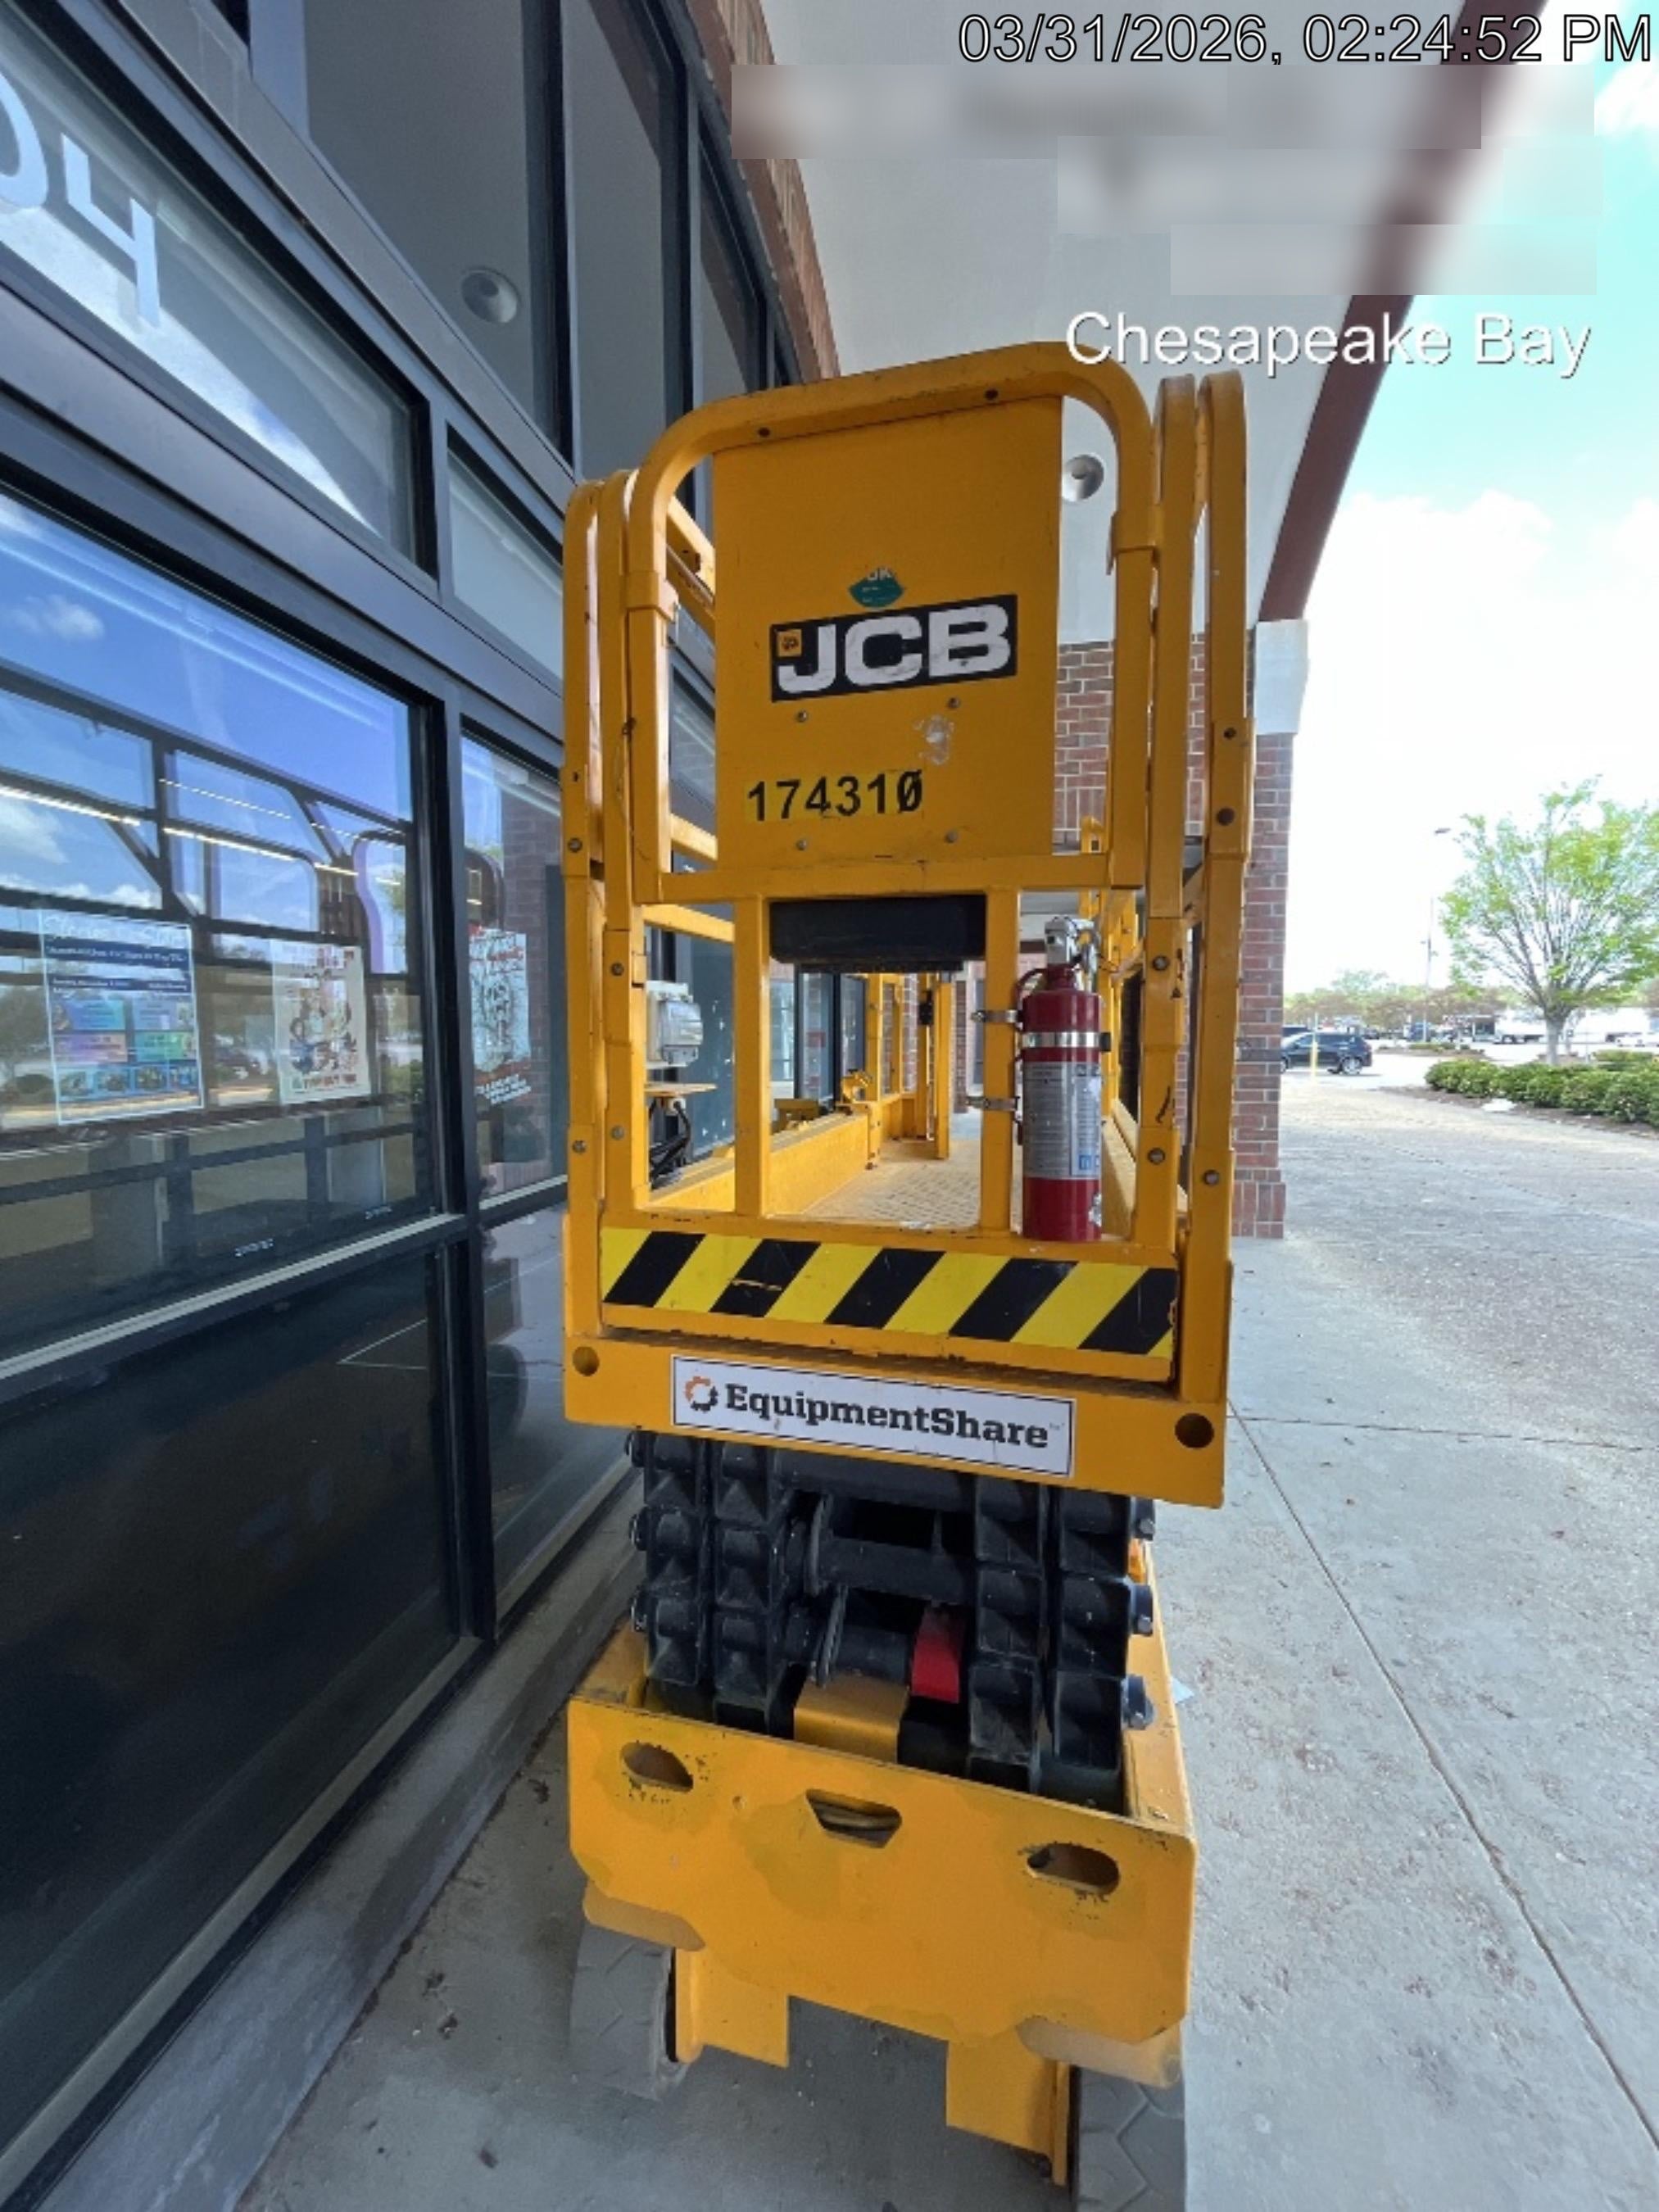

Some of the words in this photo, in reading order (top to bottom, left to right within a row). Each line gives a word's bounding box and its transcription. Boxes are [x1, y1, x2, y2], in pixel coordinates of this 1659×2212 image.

[777, 603, 1012, 694] JCB
[747, 770, 923, 821] 174310
[725, 1383, 1050, 1448] EquipmentShare
